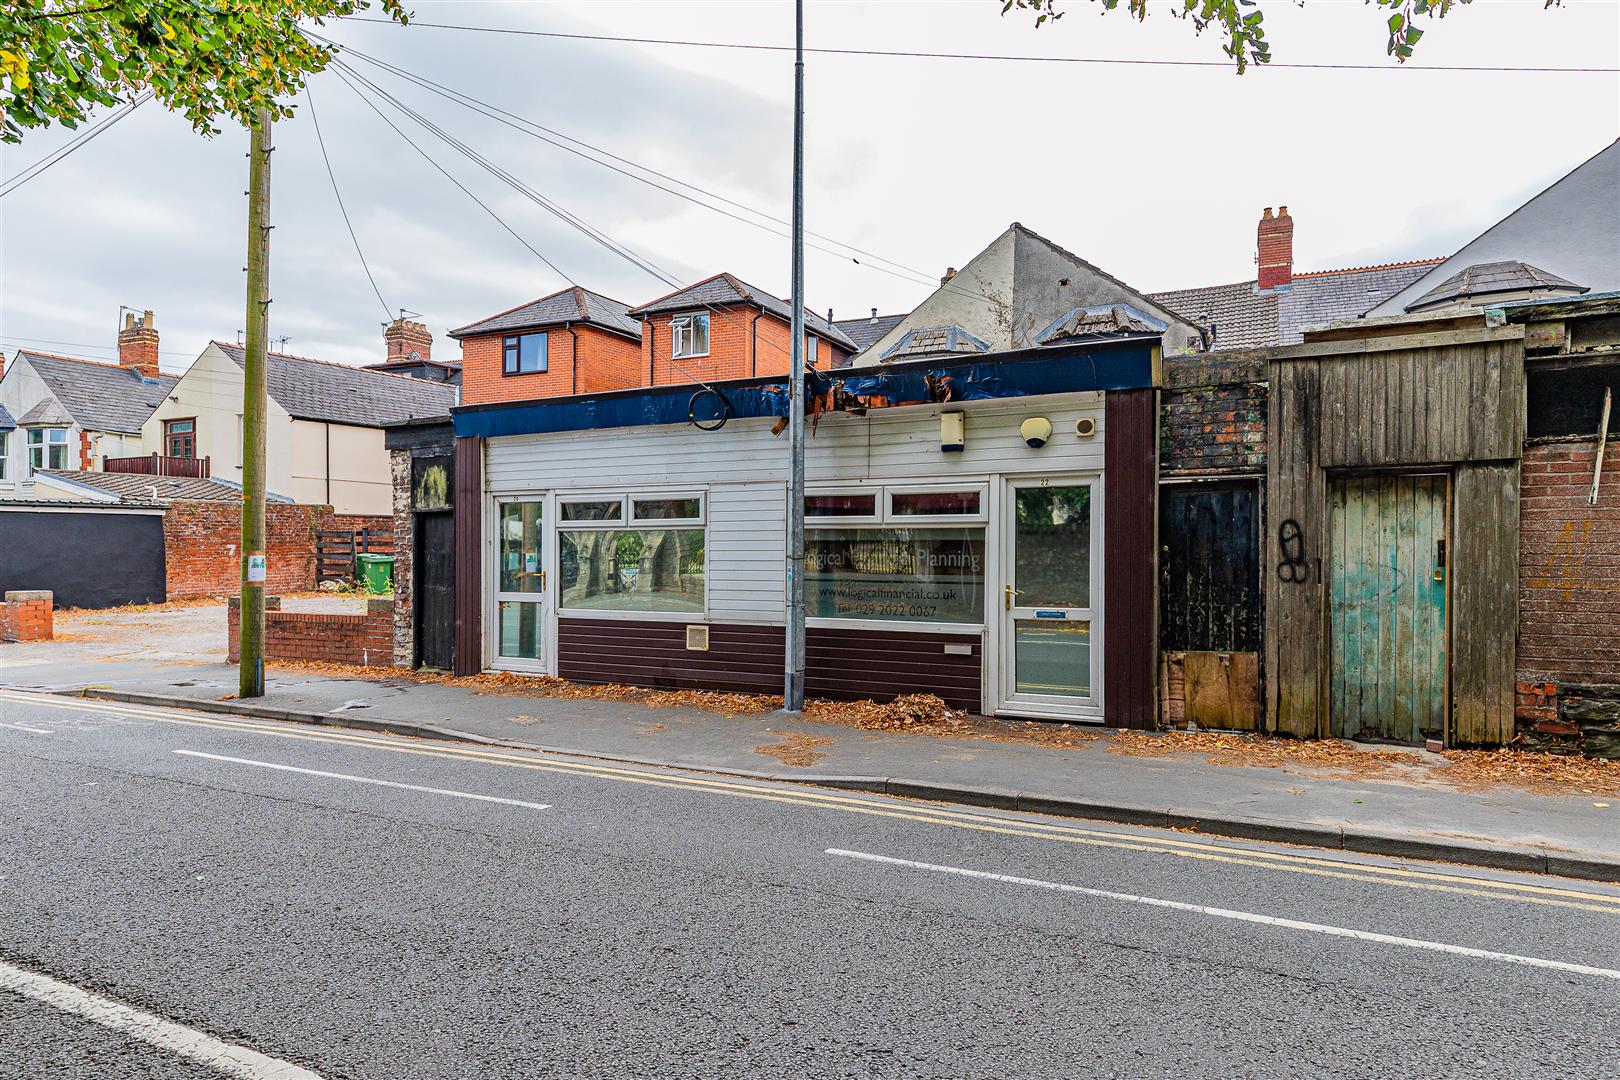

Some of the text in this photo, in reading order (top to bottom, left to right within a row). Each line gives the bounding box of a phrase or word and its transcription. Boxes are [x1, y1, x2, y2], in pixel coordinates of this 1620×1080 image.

[805, 549, 846, 570] ogical
[918, 548, 981, 572] Planning
[818, 587, 957, 601] www.logicalfinancial.co.uk
[855, 603, 875, 615] 029
[879, 604, 906, 616] 2022
[908, 605, 937, 618] 0067
